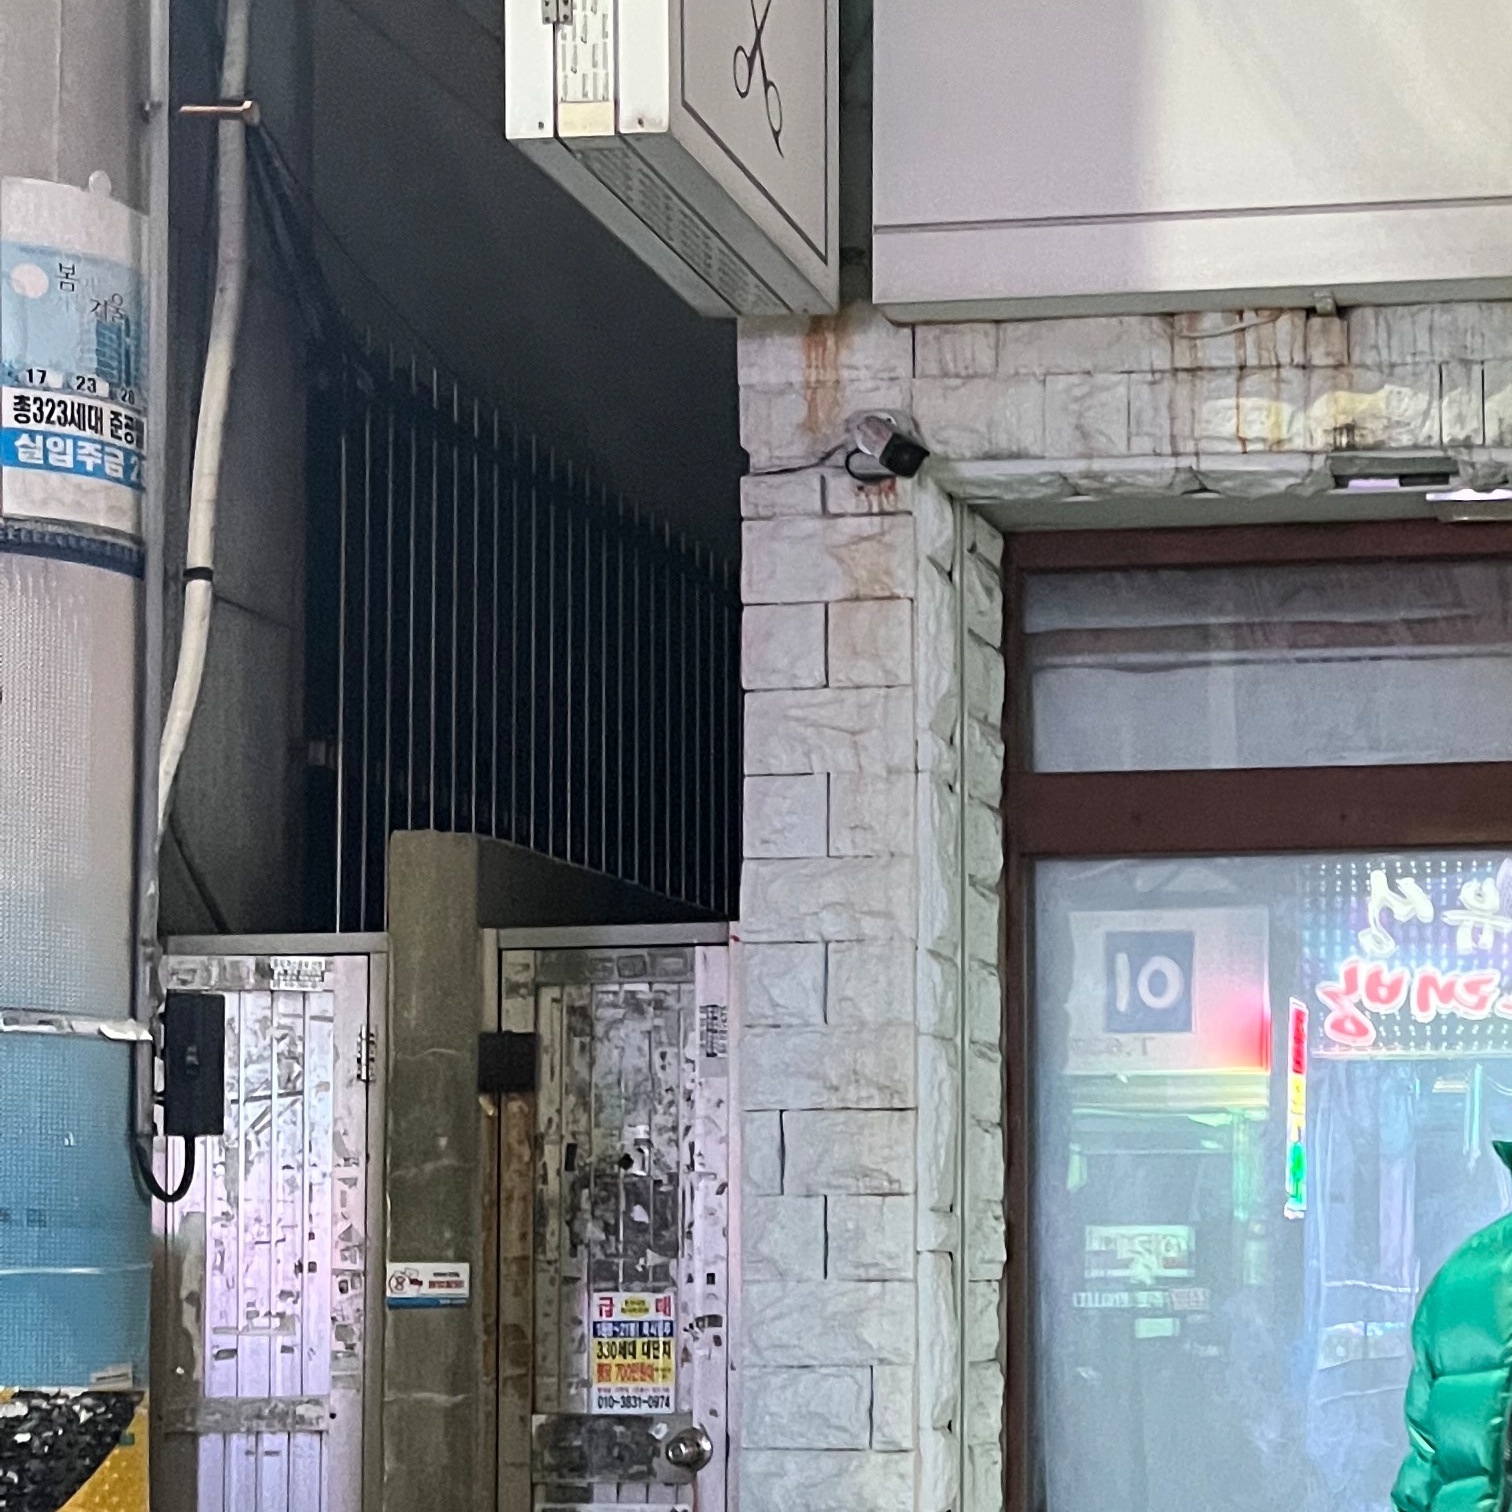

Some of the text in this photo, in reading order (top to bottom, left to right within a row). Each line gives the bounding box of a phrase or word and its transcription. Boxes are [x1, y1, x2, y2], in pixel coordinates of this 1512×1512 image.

[56, 261, 81, 292] 봄
[26, 367, 48, 385] 17
[75, 375, 98, 393] 23
[14, 432, 125, 479] 실입주금
